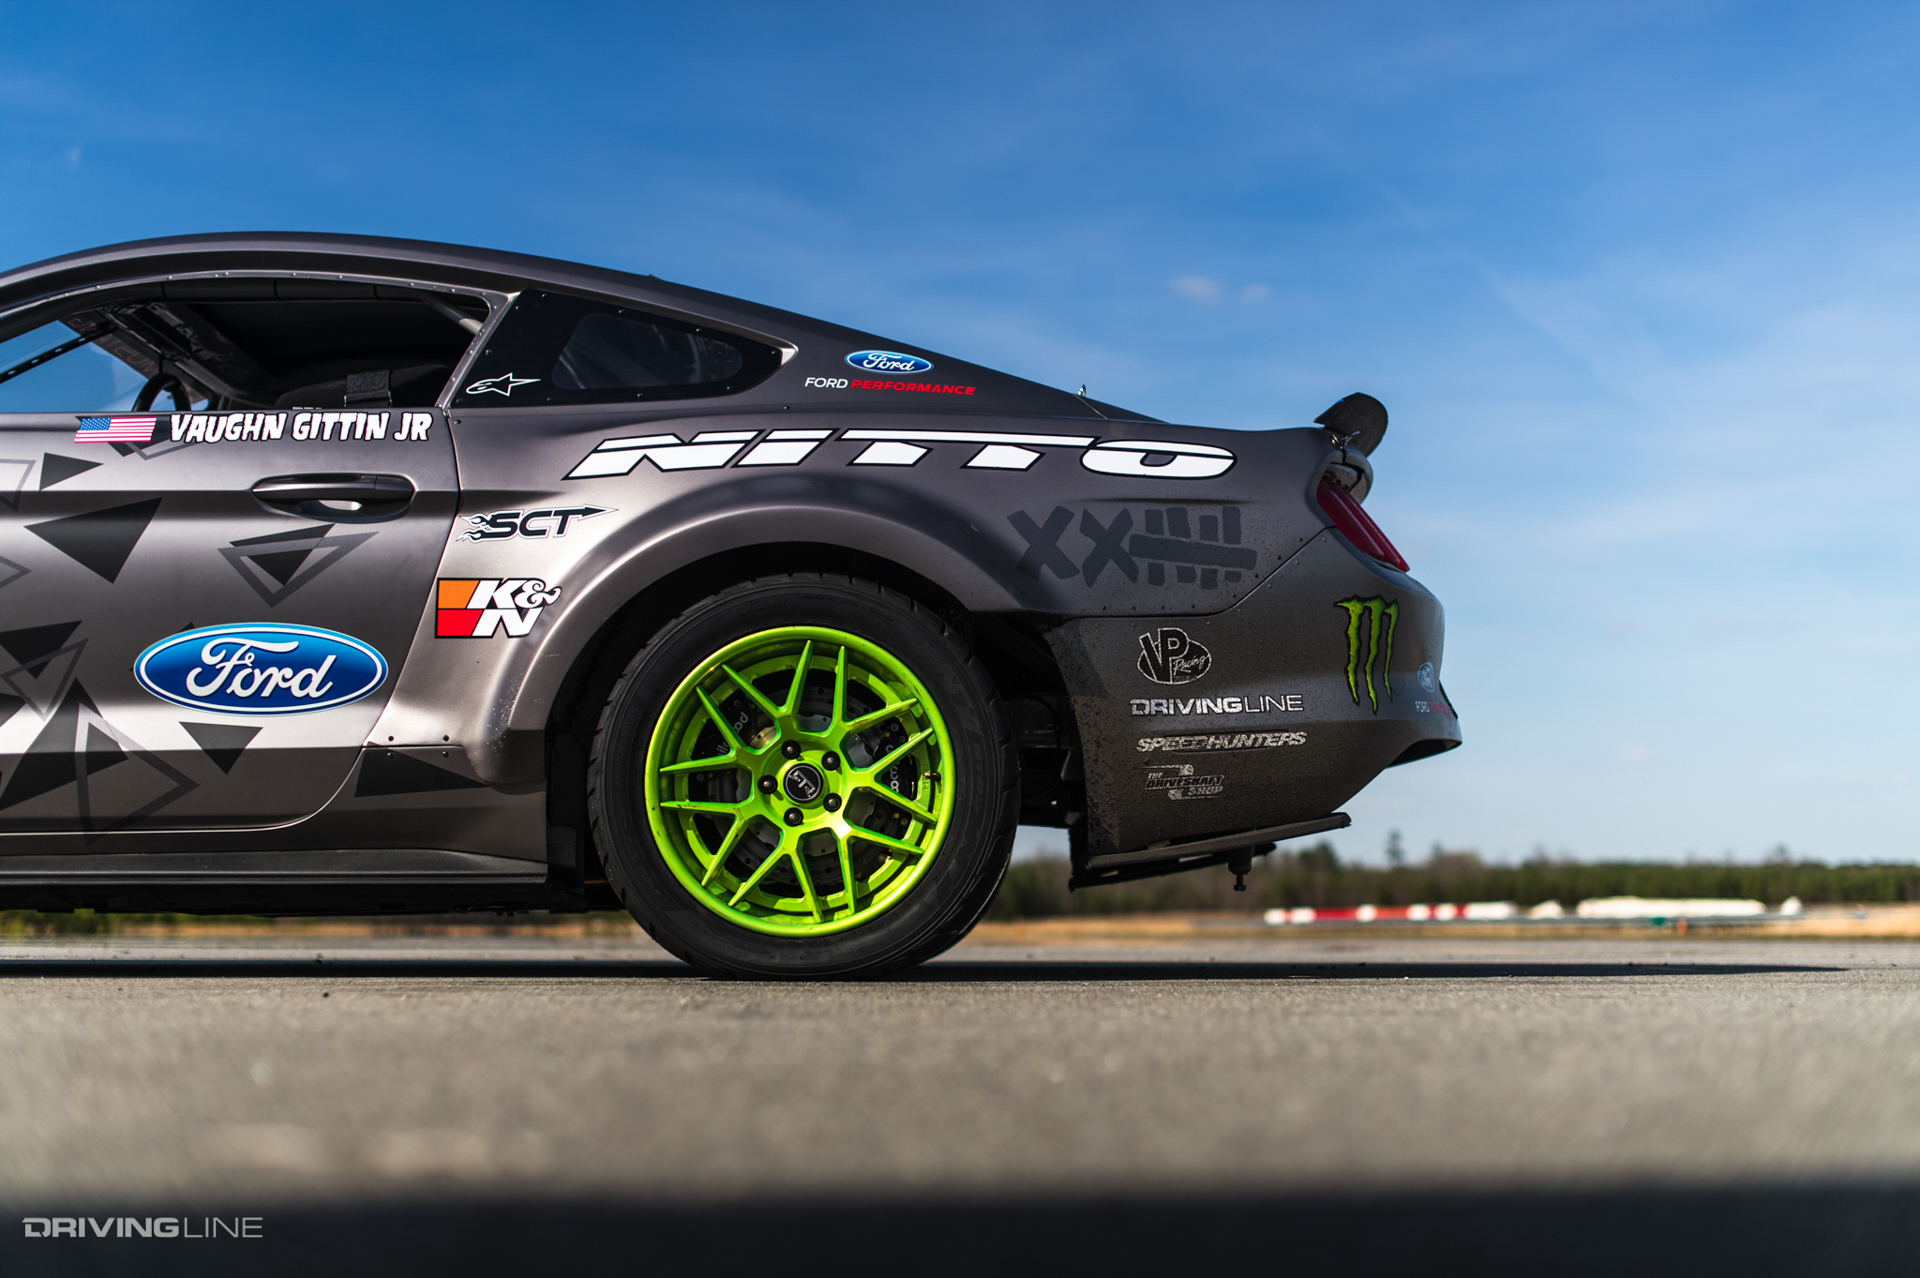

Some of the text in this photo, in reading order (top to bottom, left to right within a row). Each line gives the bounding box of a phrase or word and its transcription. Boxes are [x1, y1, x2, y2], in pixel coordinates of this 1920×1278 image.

[862, 352, 916, 371] Ford
[804, 376, 976, 396] FORD PERFORMANCE
[169, 412, 433, 443] VAUGHN GITTIN JR
[562, 428, 1237, 480] NITTO
[478, 507, 602, 542] SCT
[186, 637, 338, 699] Ford
[1139, 628, 1190, 684] VP
[1172, 655, 1207, 676] Racing
[1136, 731, 1308, 752] SPEEDHUNTERS
